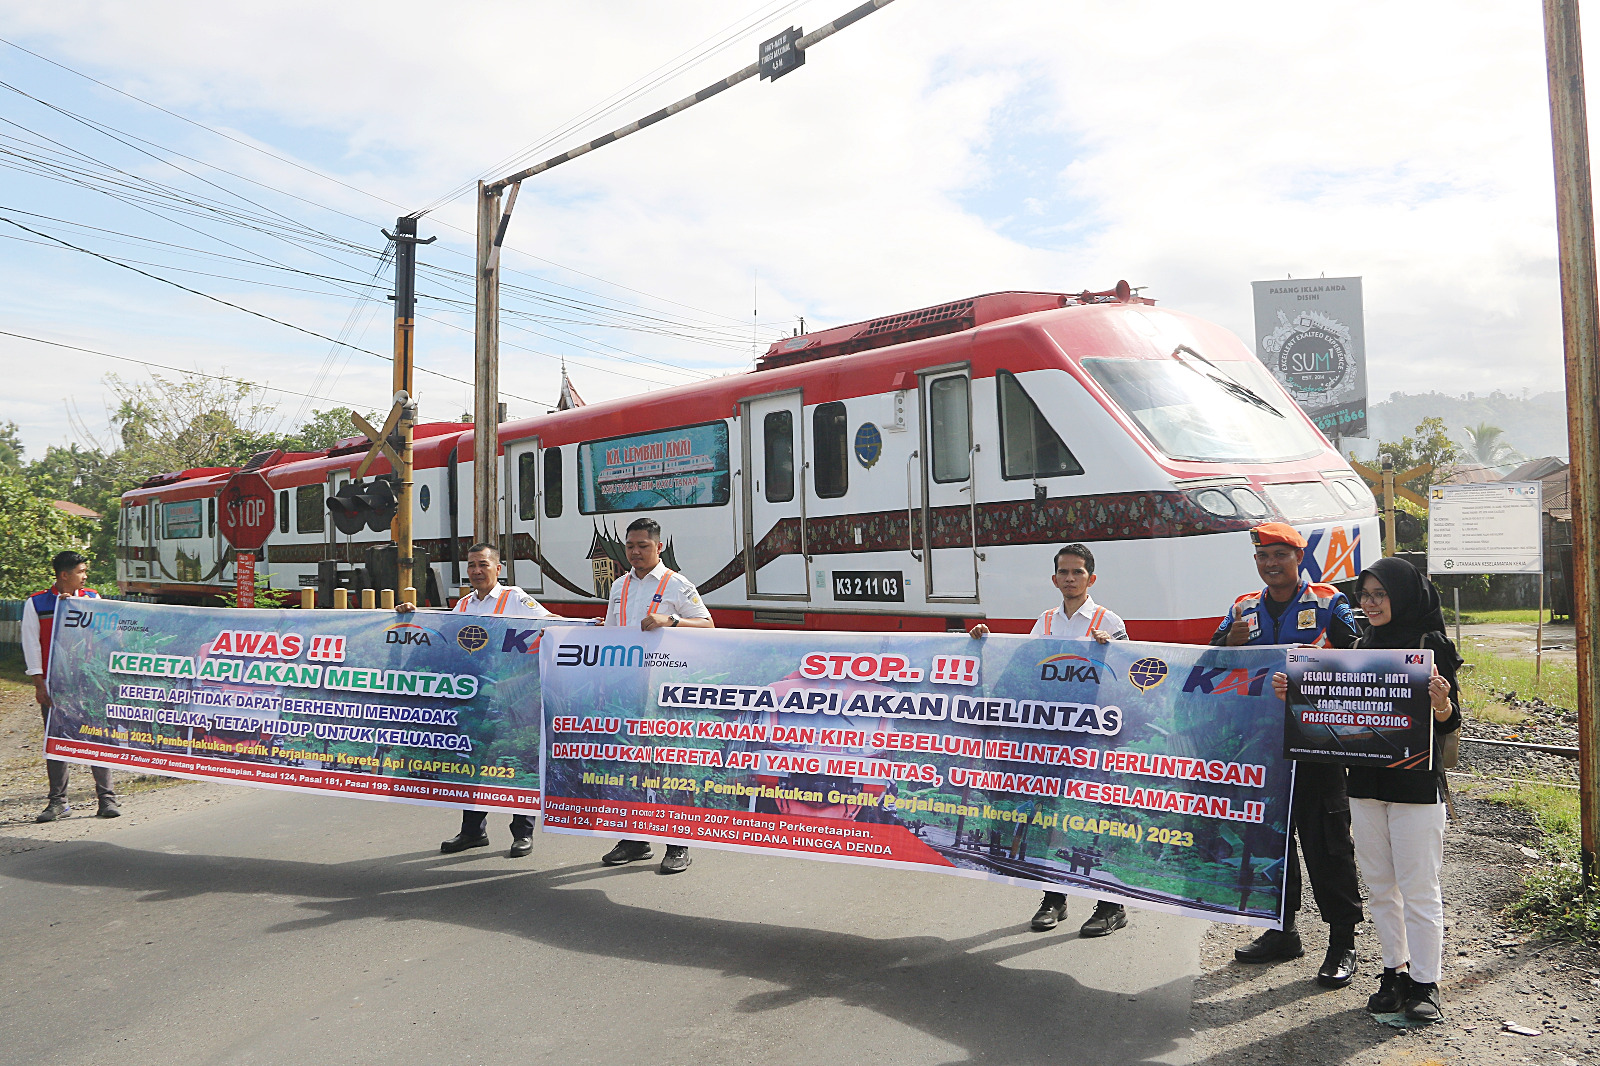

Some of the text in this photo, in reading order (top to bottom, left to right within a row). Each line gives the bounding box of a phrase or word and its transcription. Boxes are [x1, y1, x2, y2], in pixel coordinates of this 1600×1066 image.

[1270, 287, 1299, 295] PASANG
[1282, 331, 1345, 371] EXCELLENT EXALTED EXPERIENCE
[623, 442, 663, 463] LEMBAH
[665, 438, 691, 457] ANAI
[673, 476, 698, 488] TANAM
[227, 499, 266, 528] STOP
[1298, 524, 1362, 583] KAI
[836, 578, 852, 595] K3
[854, 578, 862, 595] 2
[865, 578, 879, 595] 11
[882, 578, 898, 596] 03
[64, 609, 119, 631] BUMN
[117, 625, 149, 633] INDONESIA
[211, 632, 343, 659] AWAS !!!
[386, 630, 432, 646] DJKA
[556, 644, 643, 667] BUMN
[643, 659, 688, 668] INDONESIA
[644, 652, 671, 660] UNTUK
[803, 655, 975, 682] STOP.. !!!
[111, 654, 475, 696] KERETA API AKAN MELINTAS
[1040, 664, 1100, 684] DJKA
[1182, 665, 1270, 697] KAI
[1302, 671, 1409, 684] SELALU BERHATI HATI
[120, 685, 458, 725] KERETA API TIDAK DAPAT BERHENTI MENDADAK
[1300, 685, 1412, 699] LIHAT KANAN DAN KIRI
[1316, 699, 1393, 712] SAAT MELINTASI
[661, 685, 1119, 732] KERETA API AKAN MELINTAS
[1302, 712, 1409, 727] PASSENGER CROSSING
[107, 704, 472, 751] HINDARI CELAKA, TETAP HIDUP UNTUK KELUARGA
[79, 724, 516, 779] Mulai 1 Juni 2023, Pemberlakukan Grafik Perjalanan Kereta Api (GAPEKA) 2023
[553, 717, 1264, 787] SELALU TENGOK KANAN DAN KIRI SEBELUM MELINTASI PERLINTASAN
[55, 744, 100, 758] Undang-undang
[100, 750, 119, 760] nomor
[120, 752, 130, 761] 23
[130, 753, 150, 764] Tahun
[151, 756, 168, 766] 2007
[168, 760, 195, 771] tentang
[195, 762, 255, 778] Perkeretaapian.
[256, 769, 278, 779] Pasal
[279, 772, 297, 783] 124,
[299, 773, 322, 783] Pasal
[324, 776, 343, 788] 181,
[344, 780, 370, 789] Pasal
[371, 781, 391, 791] 199.
[393, 783, 430, 794] SANKSI
[432, 788, 470, 798] PIDANA
[472, 791, 515, 803] HINGGA
[553, 743, 652, 762] DAHULUKAN
[655, 747, 722, 767] KERETA
[727, 752, 760, 769] API
[766, 754, 820, 774] YANG
[826, 758, 944, 787] MELINTAS,
[951, 768, 1060, 797] UTAMAKAN
[545, 800, 874, 840] Undang-undang nomor 23 Tahun 2007 tentang Perkeretaapian.
[582, 772, 1194, 847] Mulai 1 Juni 2023, Pemberlakukan Grafik Perjalanan Kereta Api (GAPEKA) 2023
[543, 813, 570, 824] Pasal
[595, 818, 628, 828] Pasal
[671, 825, 693, 837] 199,
[697, 827, 739, 840] SANKSI
[742, 831, 789, 845] PIDANA
[792, 837, 841, 850] HINGGA
[846, 841, 892, 855] DENDA
